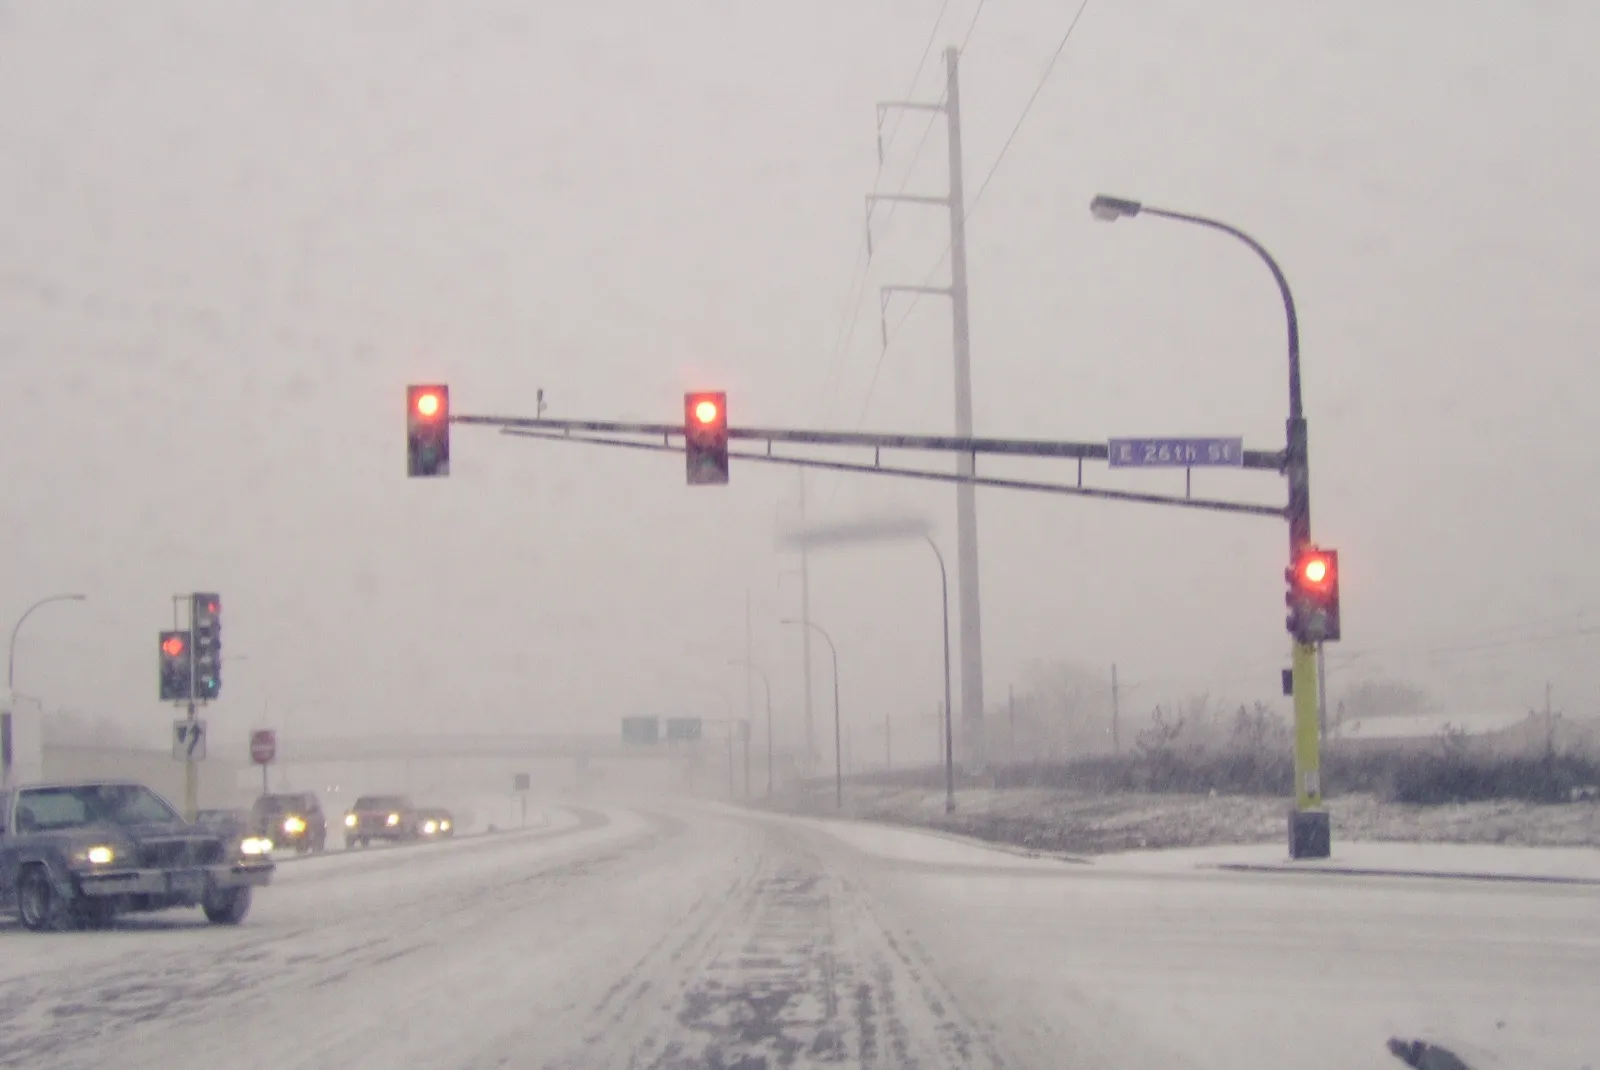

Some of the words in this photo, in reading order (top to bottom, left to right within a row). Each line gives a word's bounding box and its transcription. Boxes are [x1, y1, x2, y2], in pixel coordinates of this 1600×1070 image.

[1120, 443, 1133, 461] E
[1144, 442, 1197, 461] 26th
[1207, 442, 1233, 461] St
